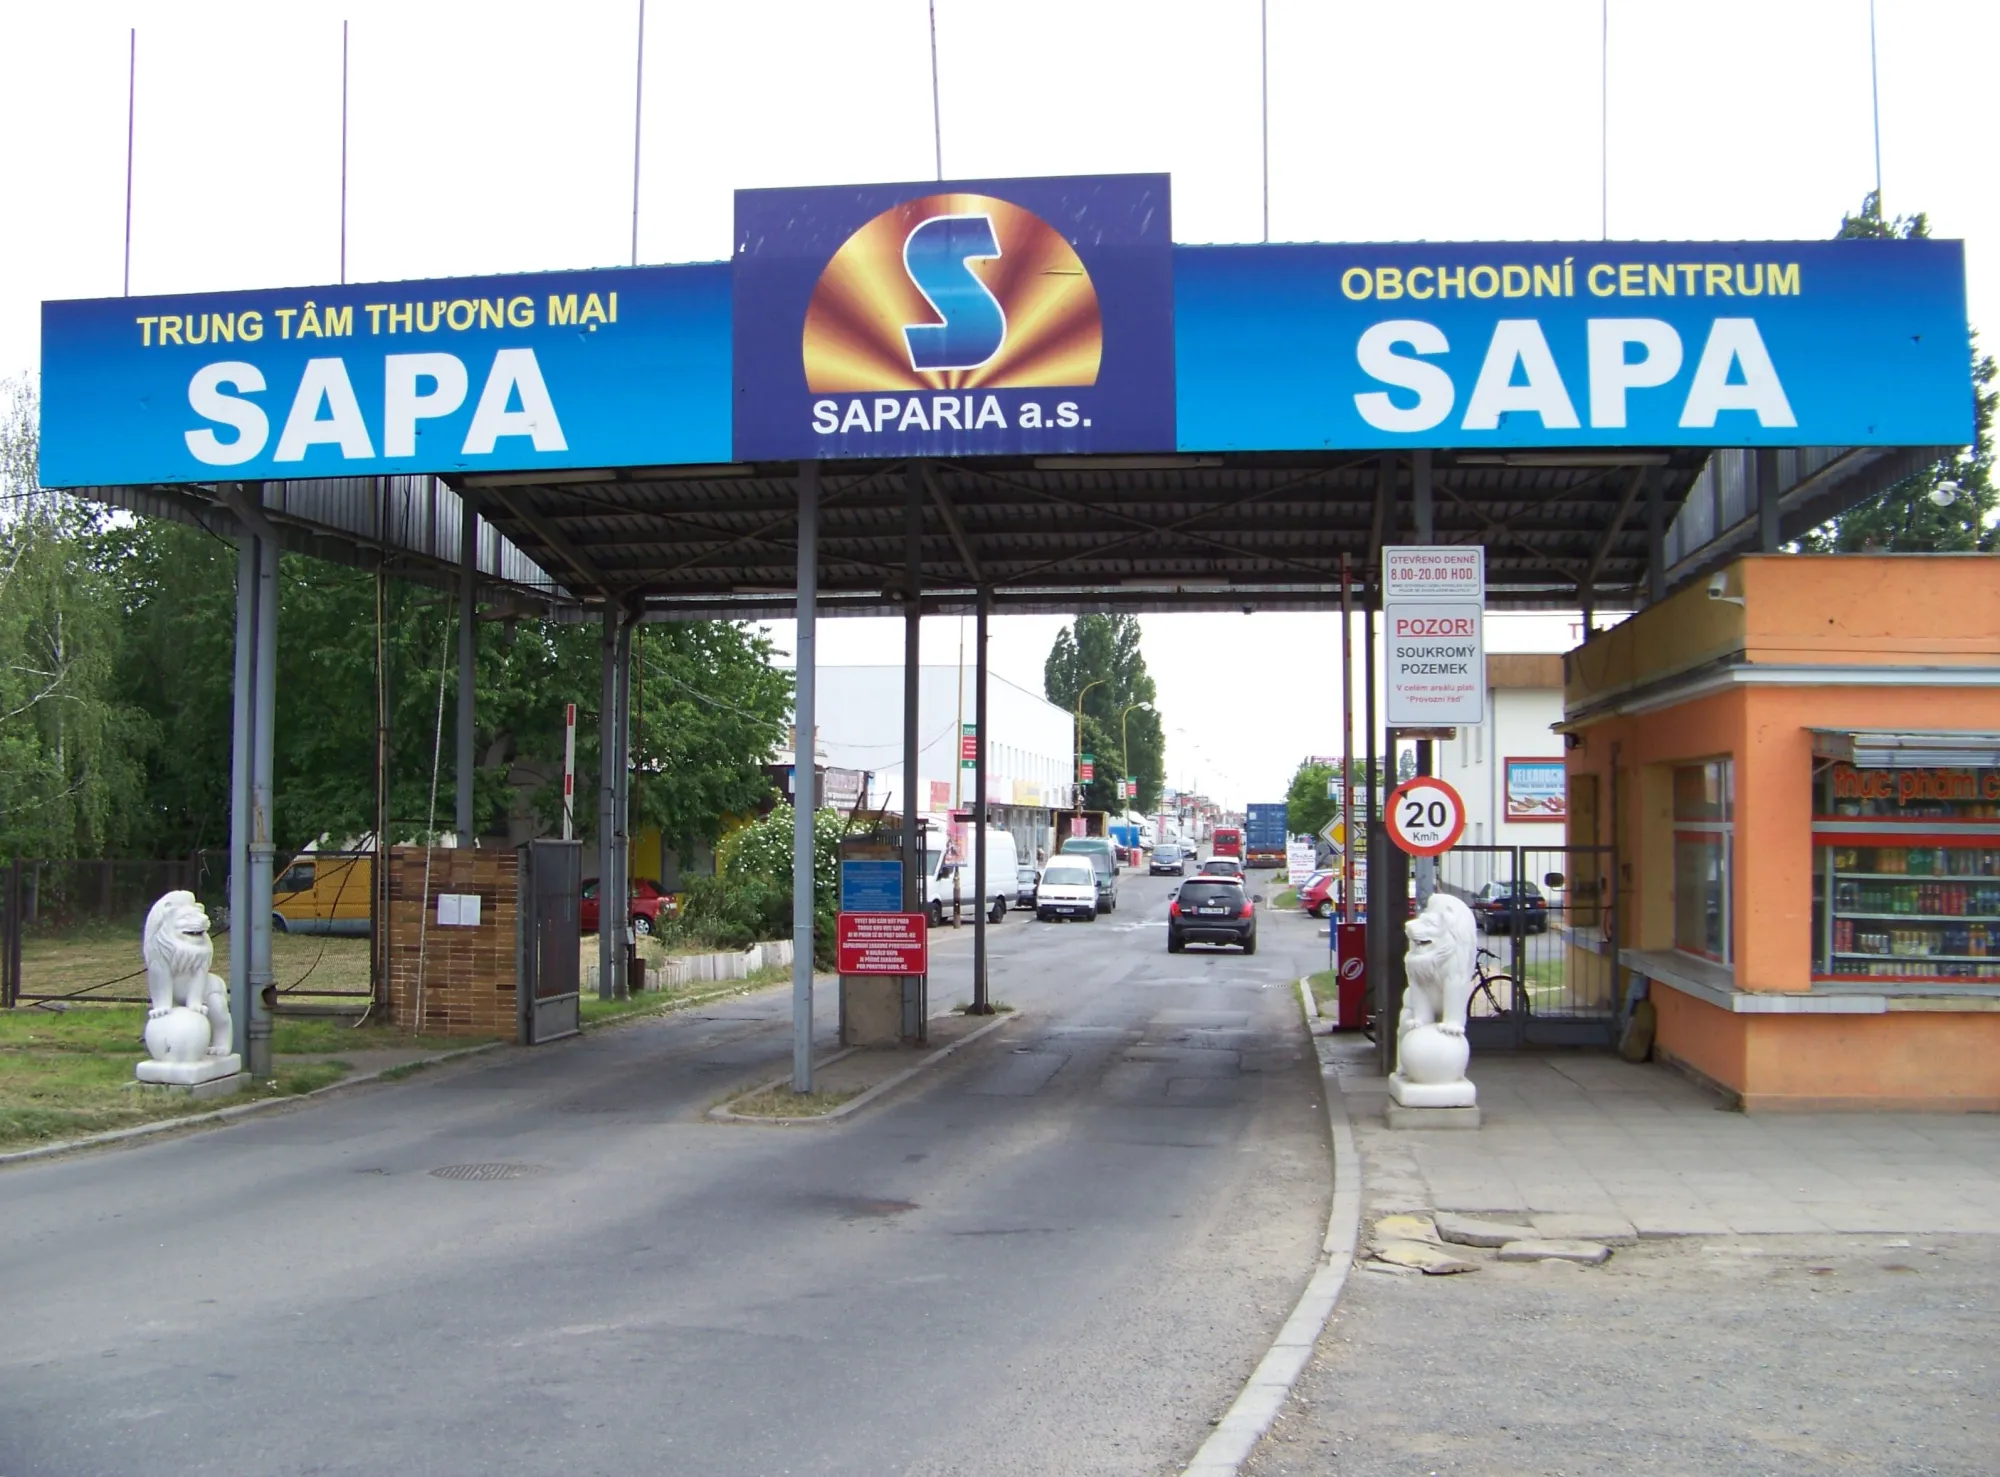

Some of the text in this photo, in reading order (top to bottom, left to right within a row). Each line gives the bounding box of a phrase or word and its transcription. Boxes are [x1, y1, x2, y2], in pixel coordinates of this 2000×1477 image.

[1341, 257, 1801, 300] OBCHODNÍ CENTRUM
[136, 292, 618, 346] TRUNG TÂM THƯƠNG MẠI
[1353, 317, 1799, 433] SAPA
[184, 347, 569, 467] SAPA
[812, 395, 1092, 434] SAPARIA a.s.
[1390, 554, 1442, 564] OTEVŘENO
[1390, 567, 1477, 580] 8.00-20.00 HOD.
[1396, 618, 1475, 635] POZOR!
[1396, 644, 1476, 658] SOUKROMÝ
[1401, 663, 1468, 675] POZEMEK
[1405, 801, 1446, 828] 20
[1413, 832, 1439, 841] Km/h
